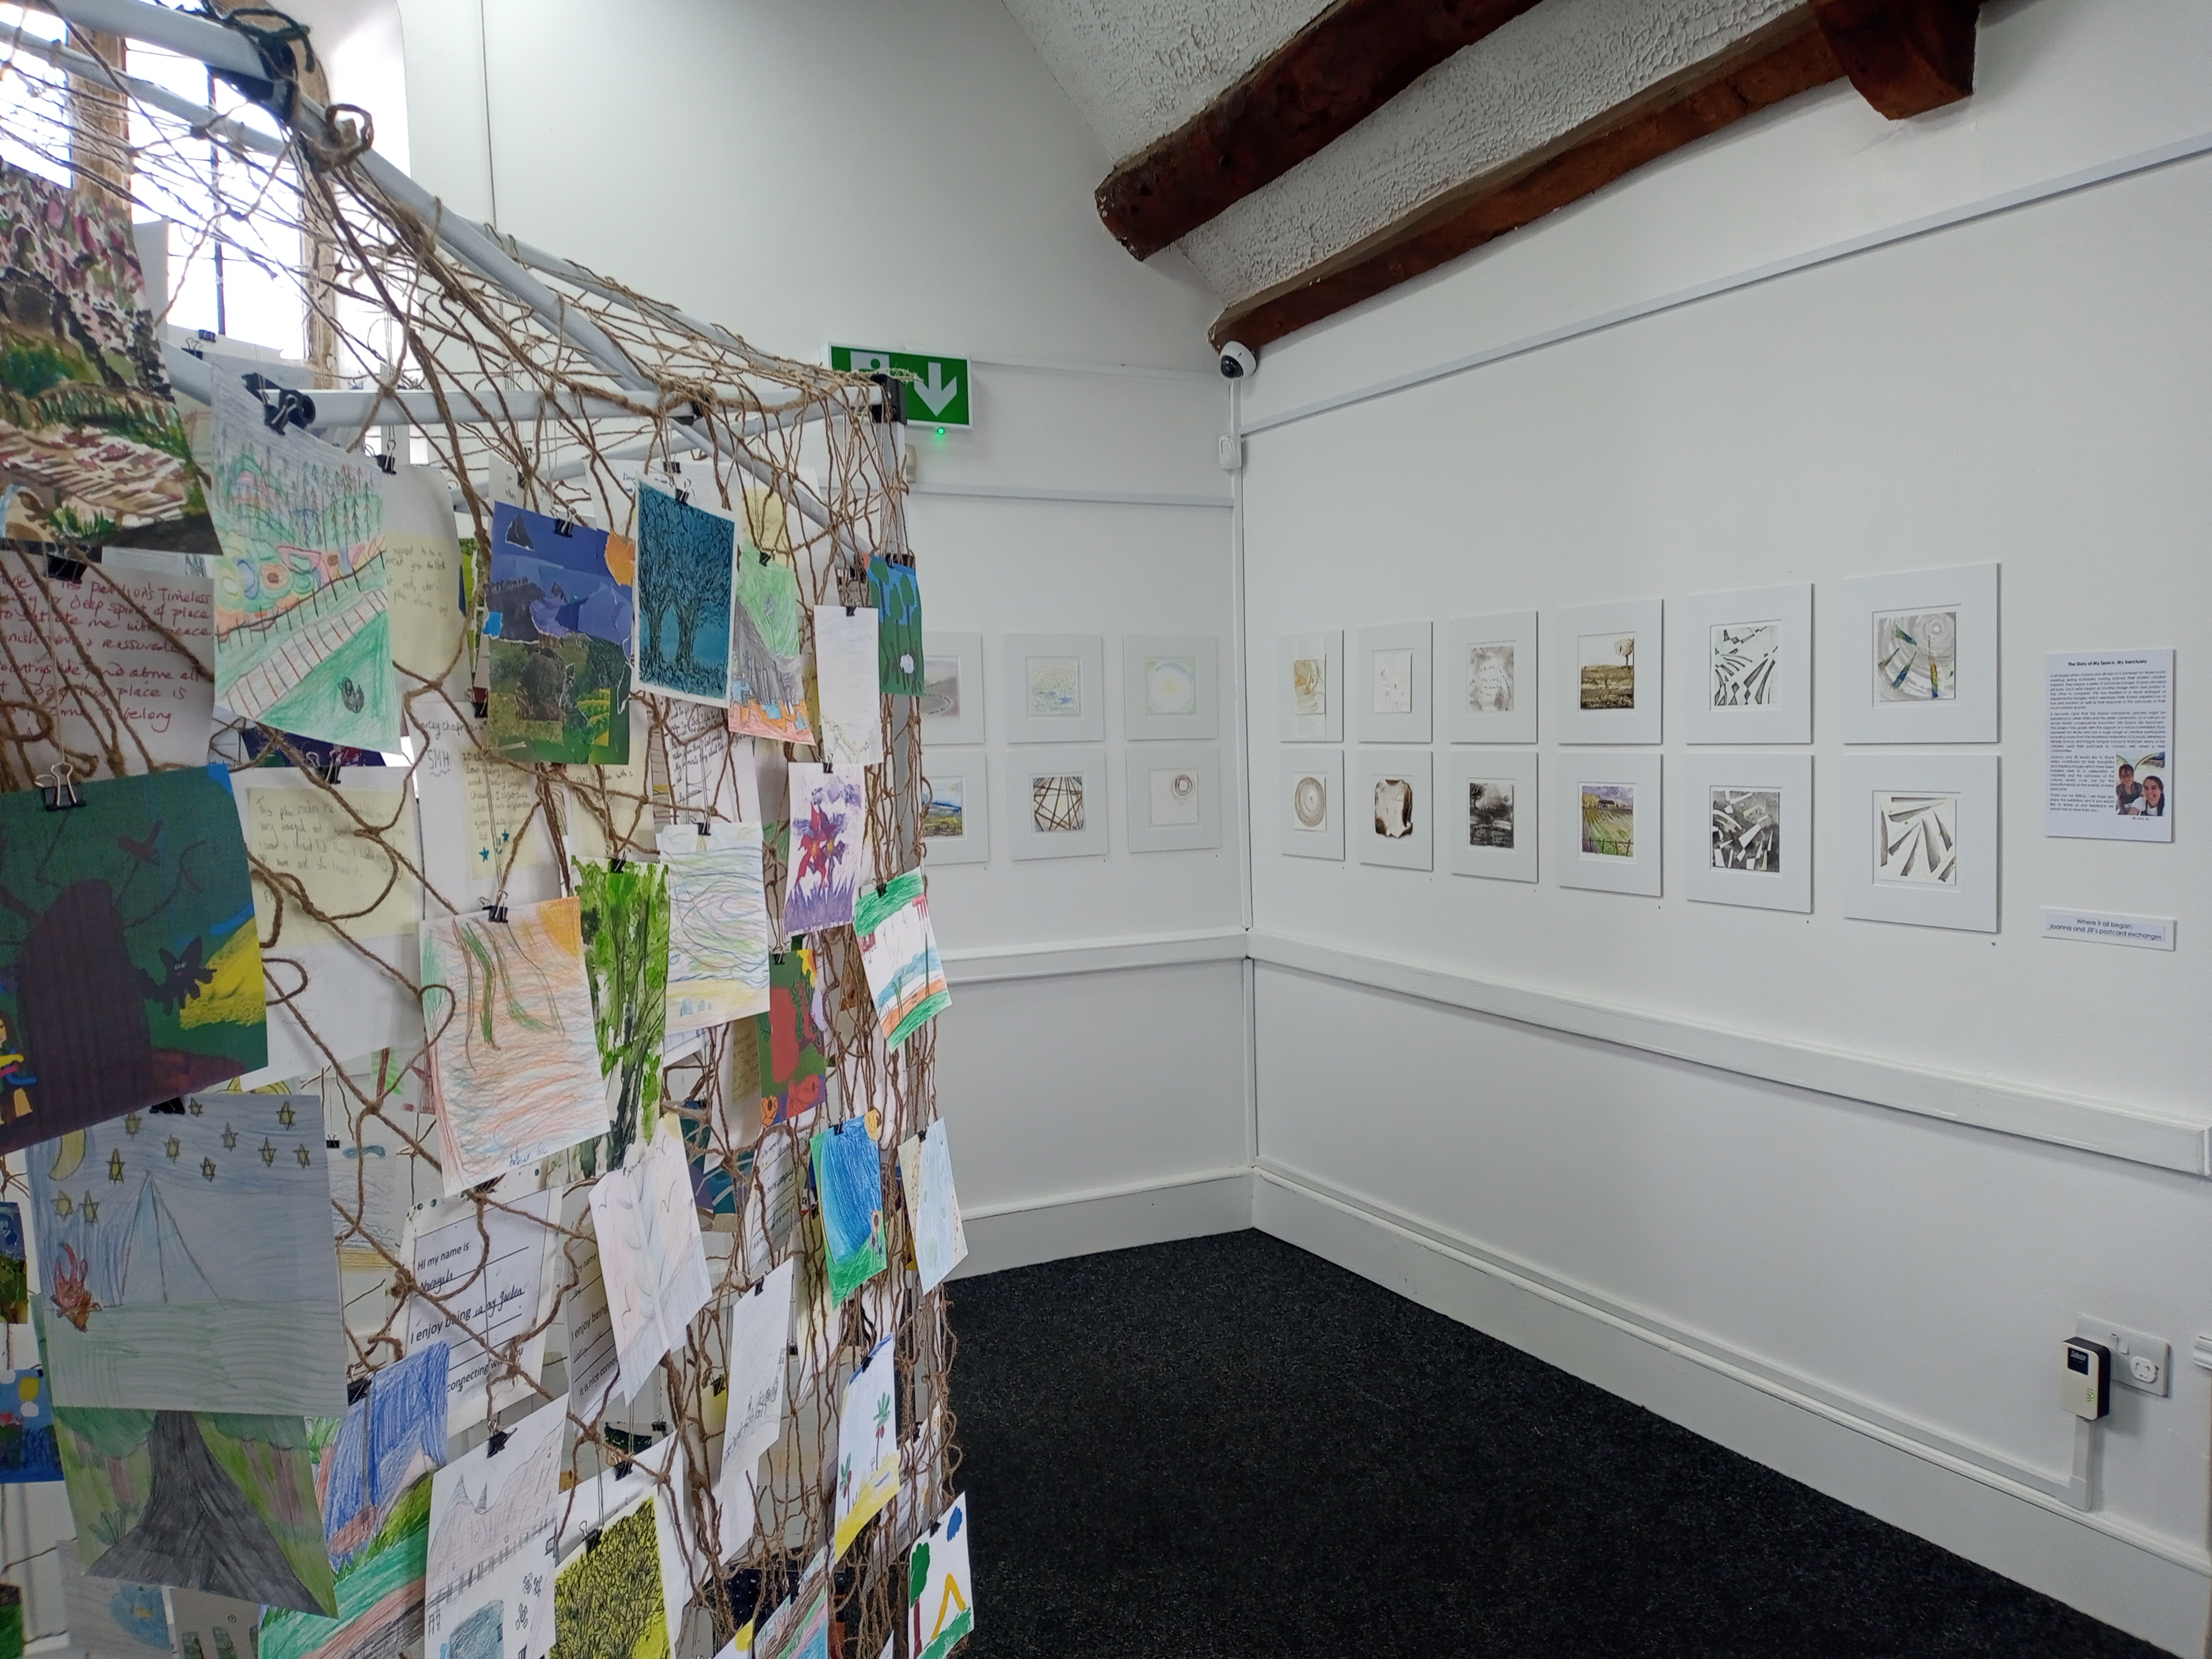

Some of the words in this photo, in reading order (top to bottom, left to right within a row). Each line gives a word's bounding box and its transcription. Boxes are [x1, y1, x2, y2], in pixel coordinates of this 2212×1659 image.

[2099, 928, 2127, 937] postcard
[417, 1261, 426, 1271] Hi
[427, 1256, 439, 1269] my
[440, 1248, 461, 1261] name
[462, 1241, 469, 1251] is
[410, 1333, 414, 1345] I
[416, 1321, 443, 1343] enjoy
[574, 1317, 591, 1337] enjoy
[591, 1303, 608, 1324] being
[447, 1364, 489, 1392] connecting
[589, 1374, 600, 1388] nice
